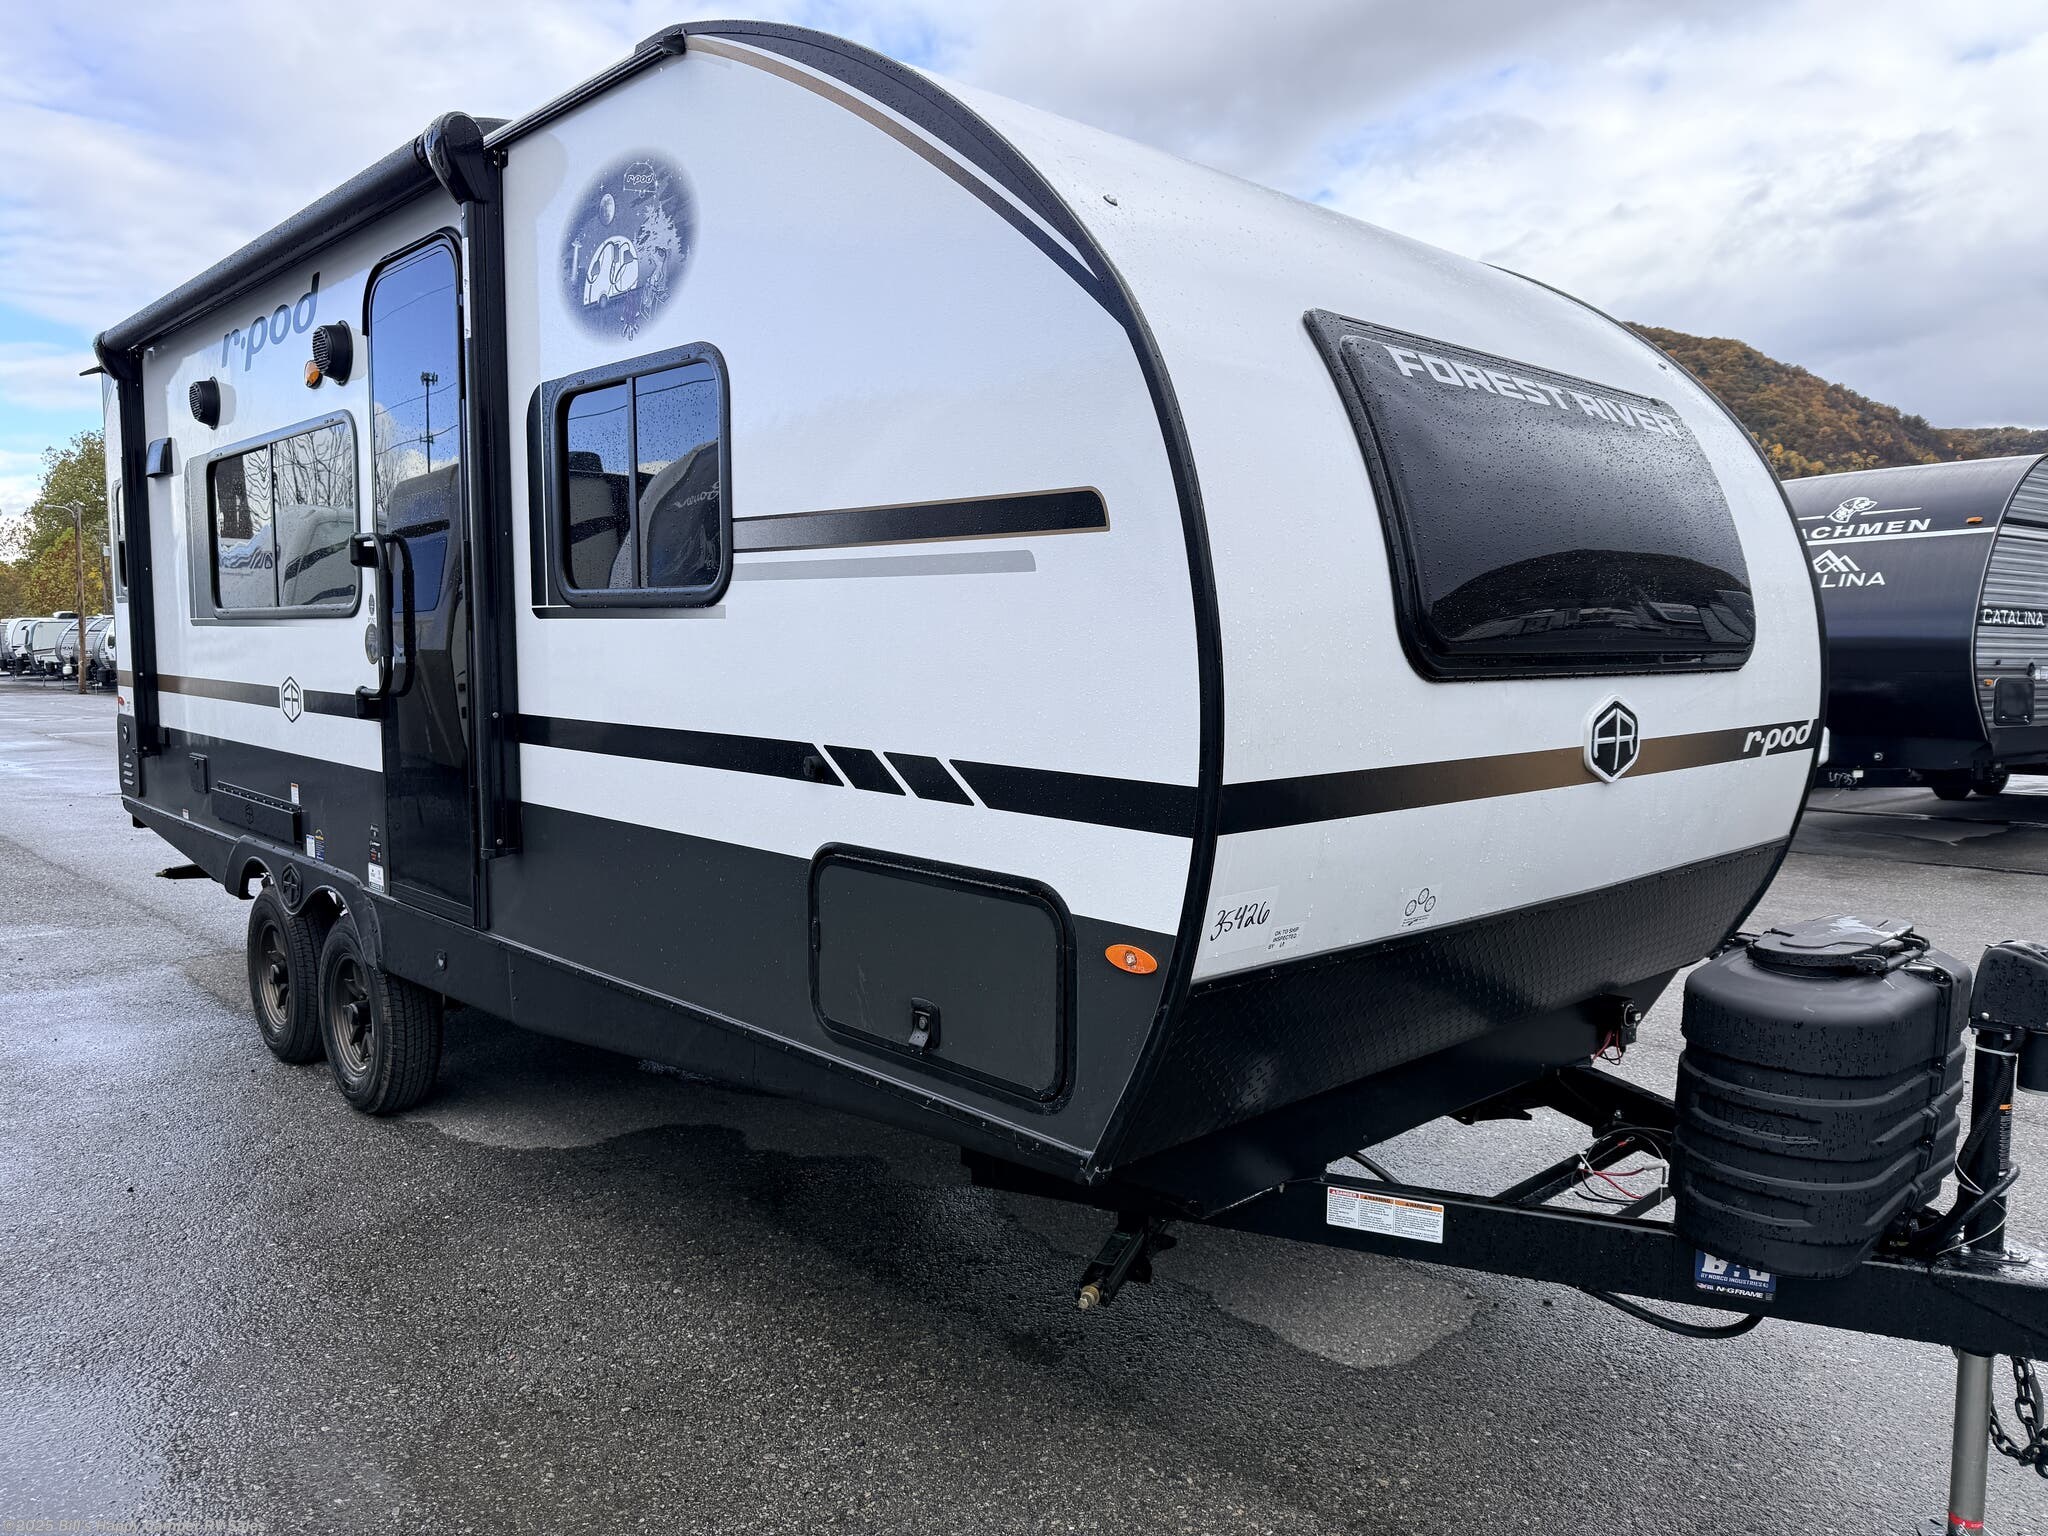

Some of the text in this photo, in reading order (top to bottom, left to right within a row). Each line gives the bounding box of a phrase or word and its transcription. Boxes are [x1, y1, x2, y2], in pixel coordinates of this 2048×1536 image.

[1383, 344, 1683, 439] FOREST RIVER
[1802, 518, 1931, 540] CHMEN
[1983, 608, 2045, 626] CATALINA
[1210, 901, 1270, 941] 35426
[1708, 1273, 1729, 1282] NORCO
